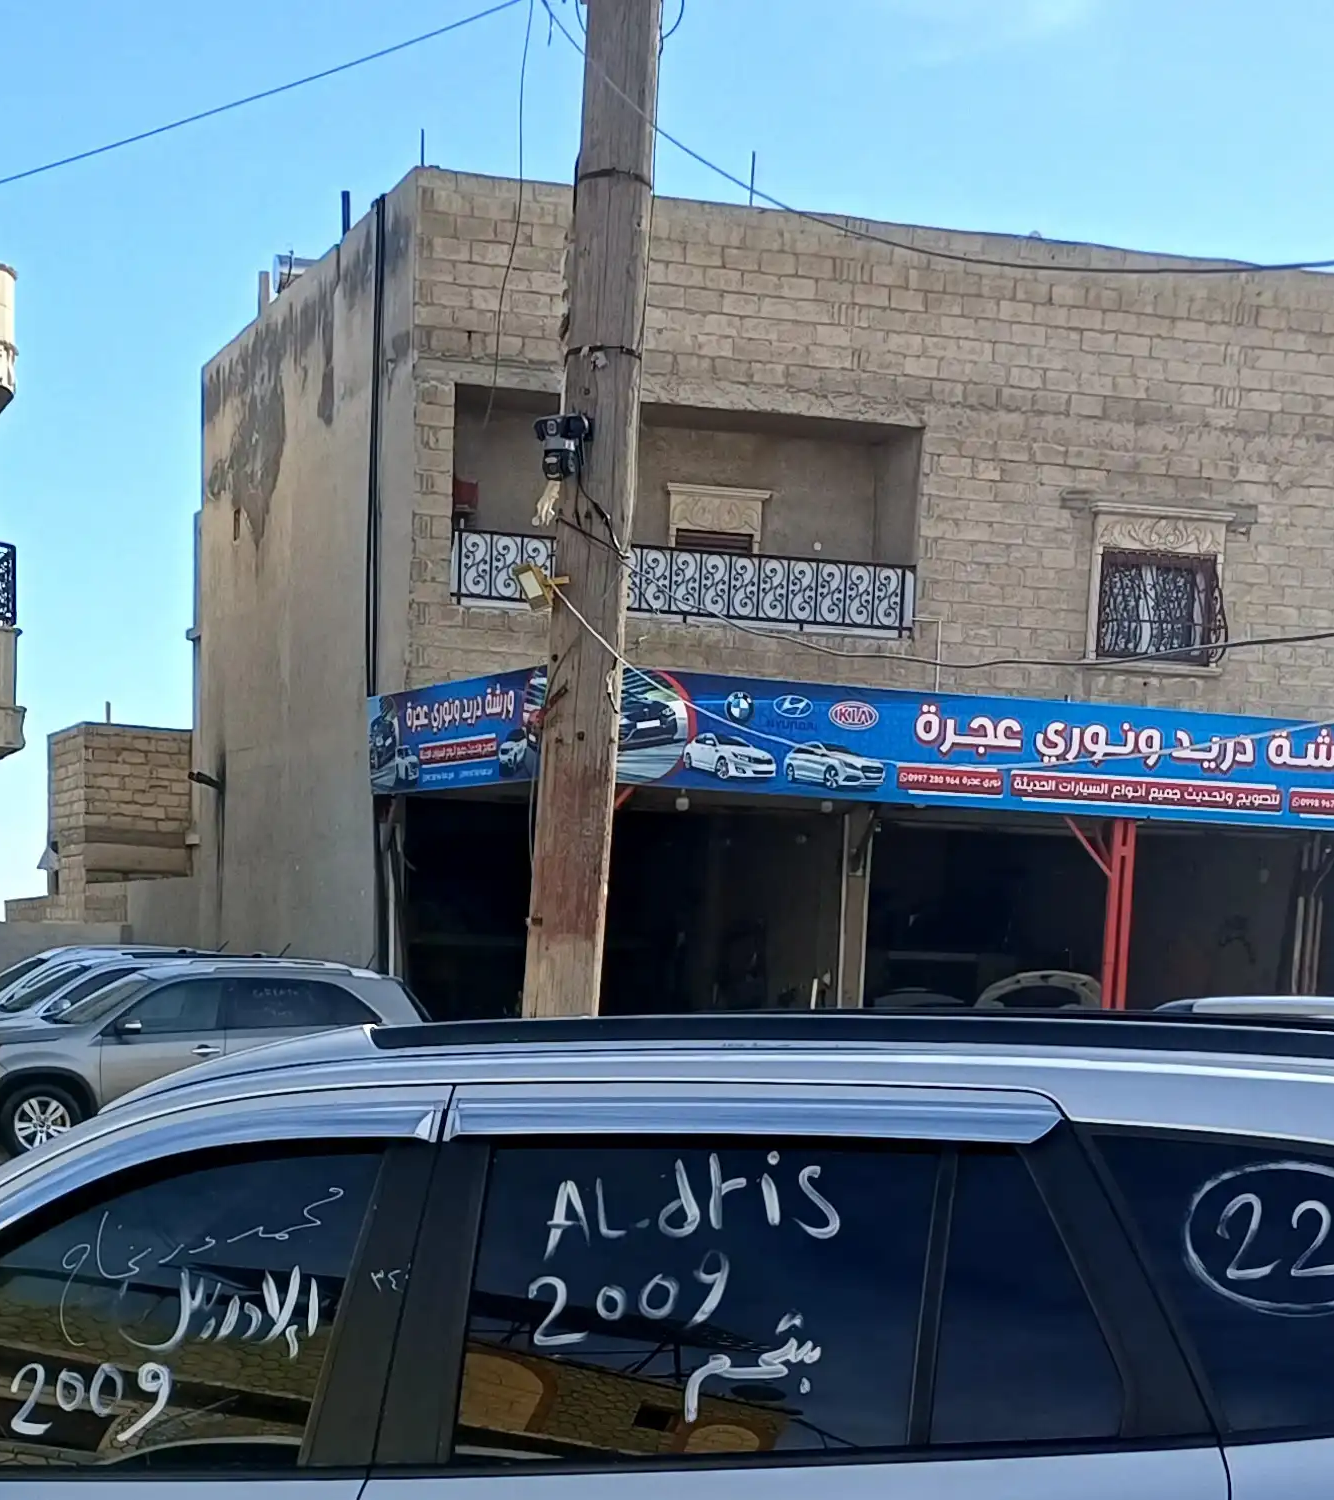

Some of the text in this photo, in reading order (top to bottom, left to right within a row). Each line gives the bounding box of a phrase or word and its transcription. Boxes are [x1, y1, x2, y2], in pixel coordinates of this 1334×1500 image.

[406, 701, 429, 732] عجرة
[462, 695, 482, 724] دريد
[485, 683, 515, 719] ورشة
[915, 704, 1022, 754] عجرة
[1034, 721, 1161, 767] ونوري
[1171, 731, 1255, 771] دريد
[1013, 777, 1056, 791] الحديثة
[1058, 781, 1109, 796] السيارات
[1148, 787, 1181, 801] جميع
[1183, 786, 1234, 805] وتحديث
[527, 1249, 730, 1346] 2009
[10, 1361, 170, 1442] 2009
